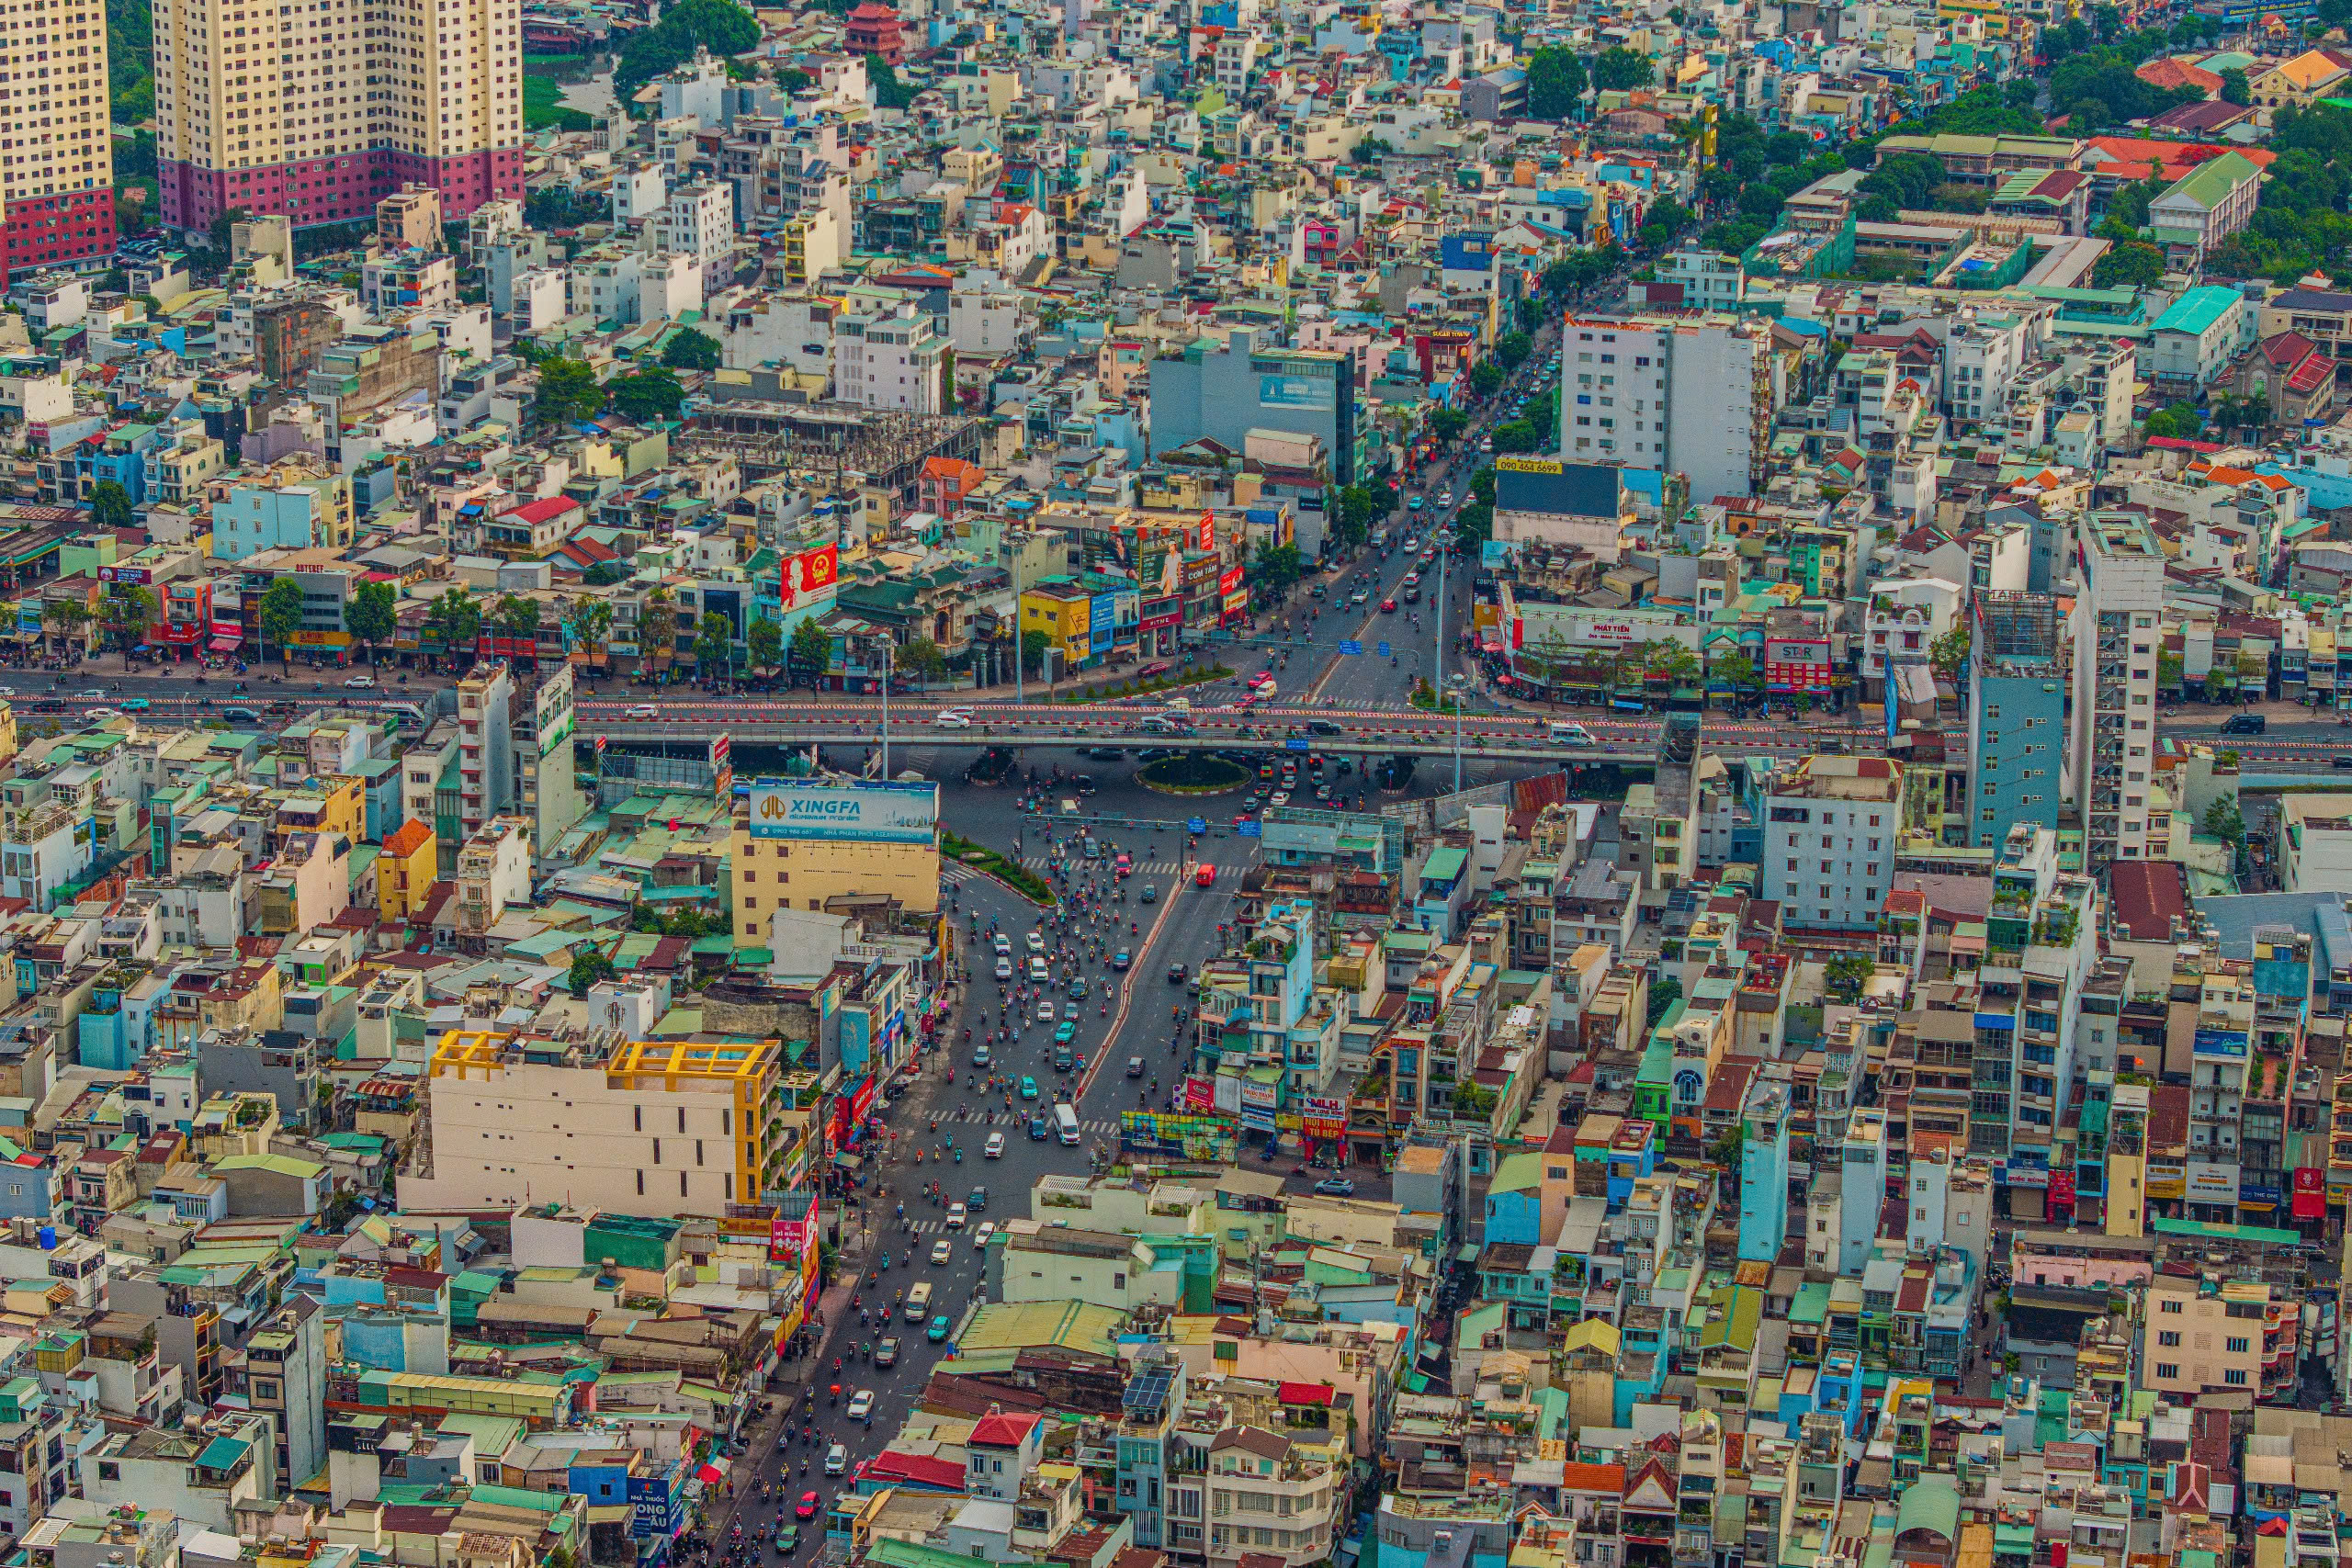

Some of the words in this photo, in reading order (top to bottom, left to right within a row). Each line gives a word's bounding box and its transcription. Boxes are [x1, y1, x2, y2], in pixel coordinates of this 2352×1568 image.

[1500, 461, 1517, 469] 090
[790, 799, 861, 814] XINGFA
[1310, 1099, 1339, 1110] MLH
[637, 1504, 666, 1515] ONG
